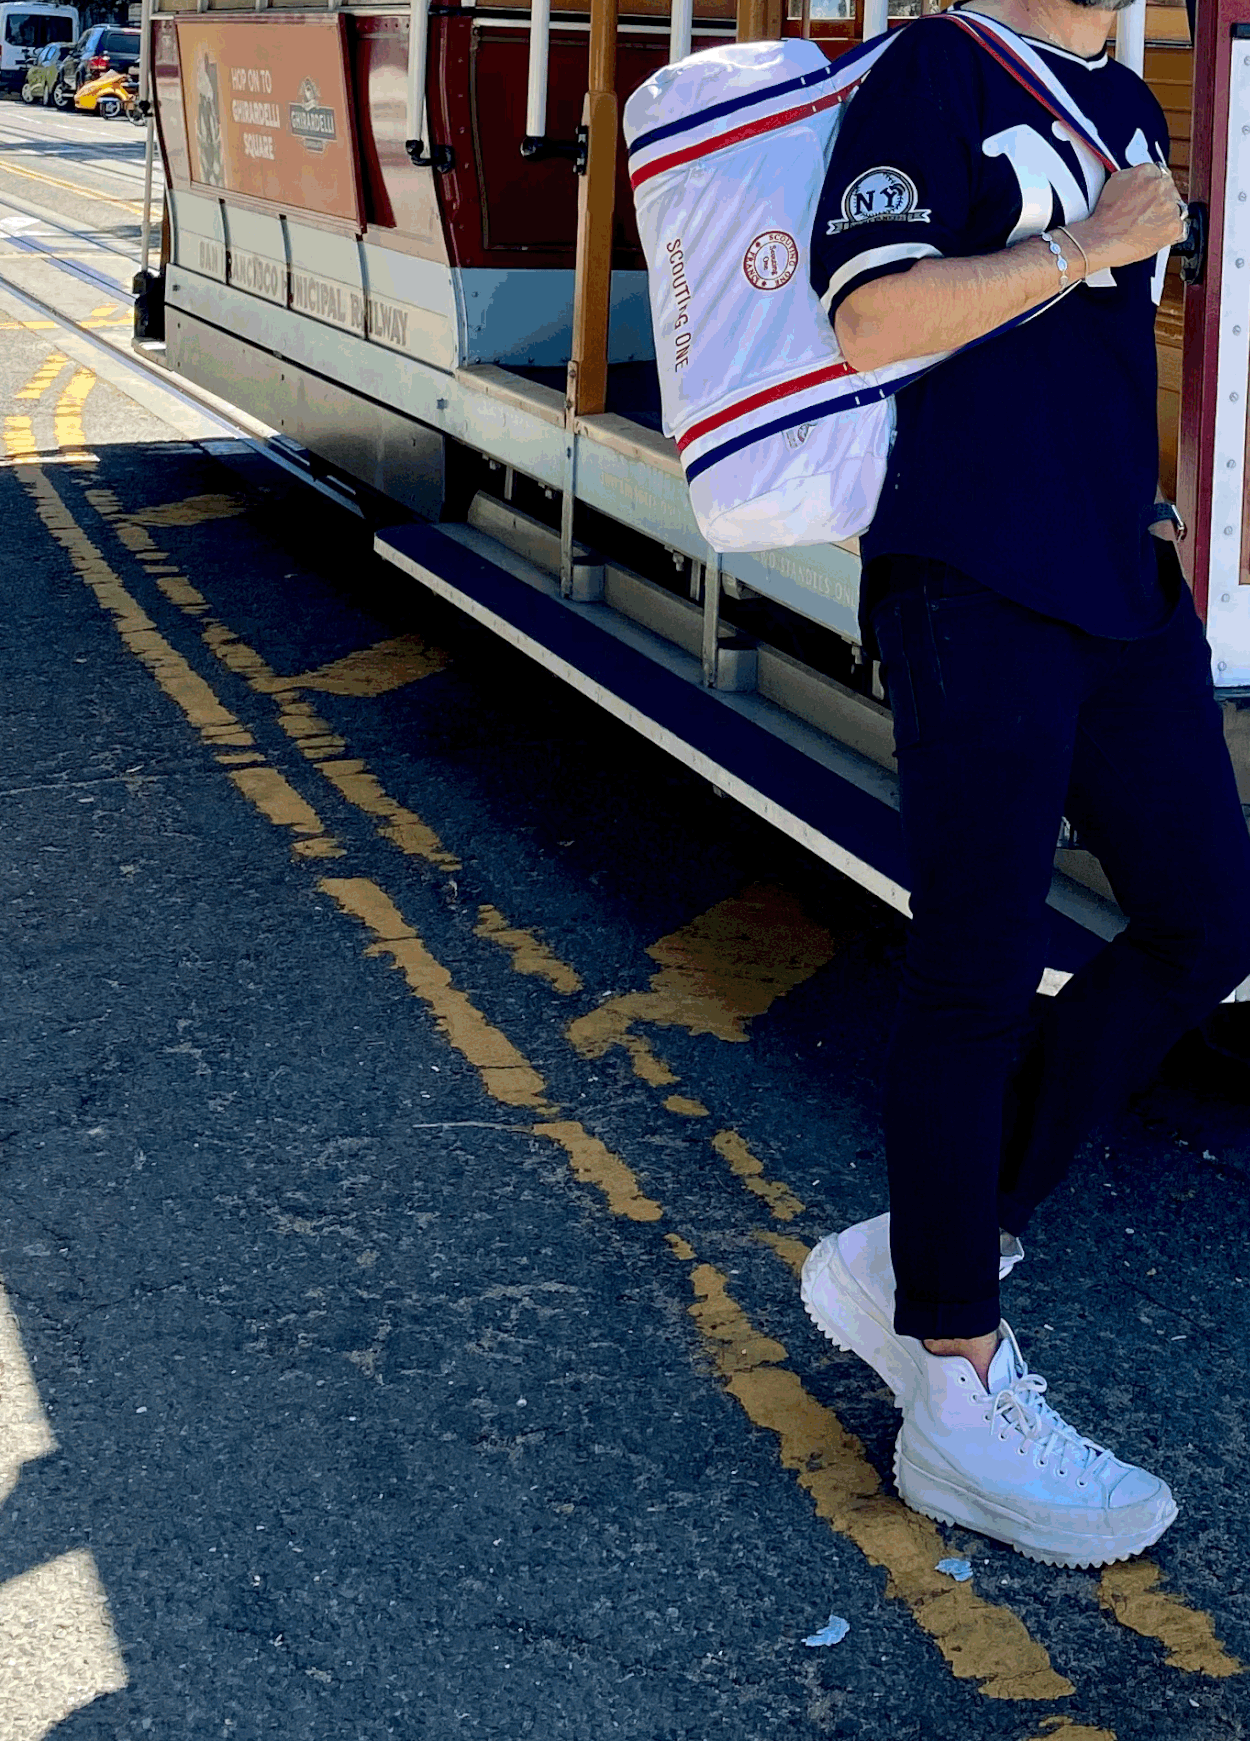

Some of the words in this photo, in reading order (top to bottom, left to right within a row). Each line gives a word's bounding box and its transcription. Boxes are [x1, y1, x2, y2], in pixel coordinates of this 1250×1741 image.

[231, 67, 246, 90] HOP
[247, 68, 260, 92] ON
[260, 69, 272, 94] TO
[232, 99, 280, 129] GHIRARDELLI
[291, 110, 335, 134] GHIRARDELLI
[243, 132, 274, 160] SQUARE
[854, 187, 898, 216] NY
[675, 332, 692, 372] ONE
[835, 582, 857, 608] ONL
